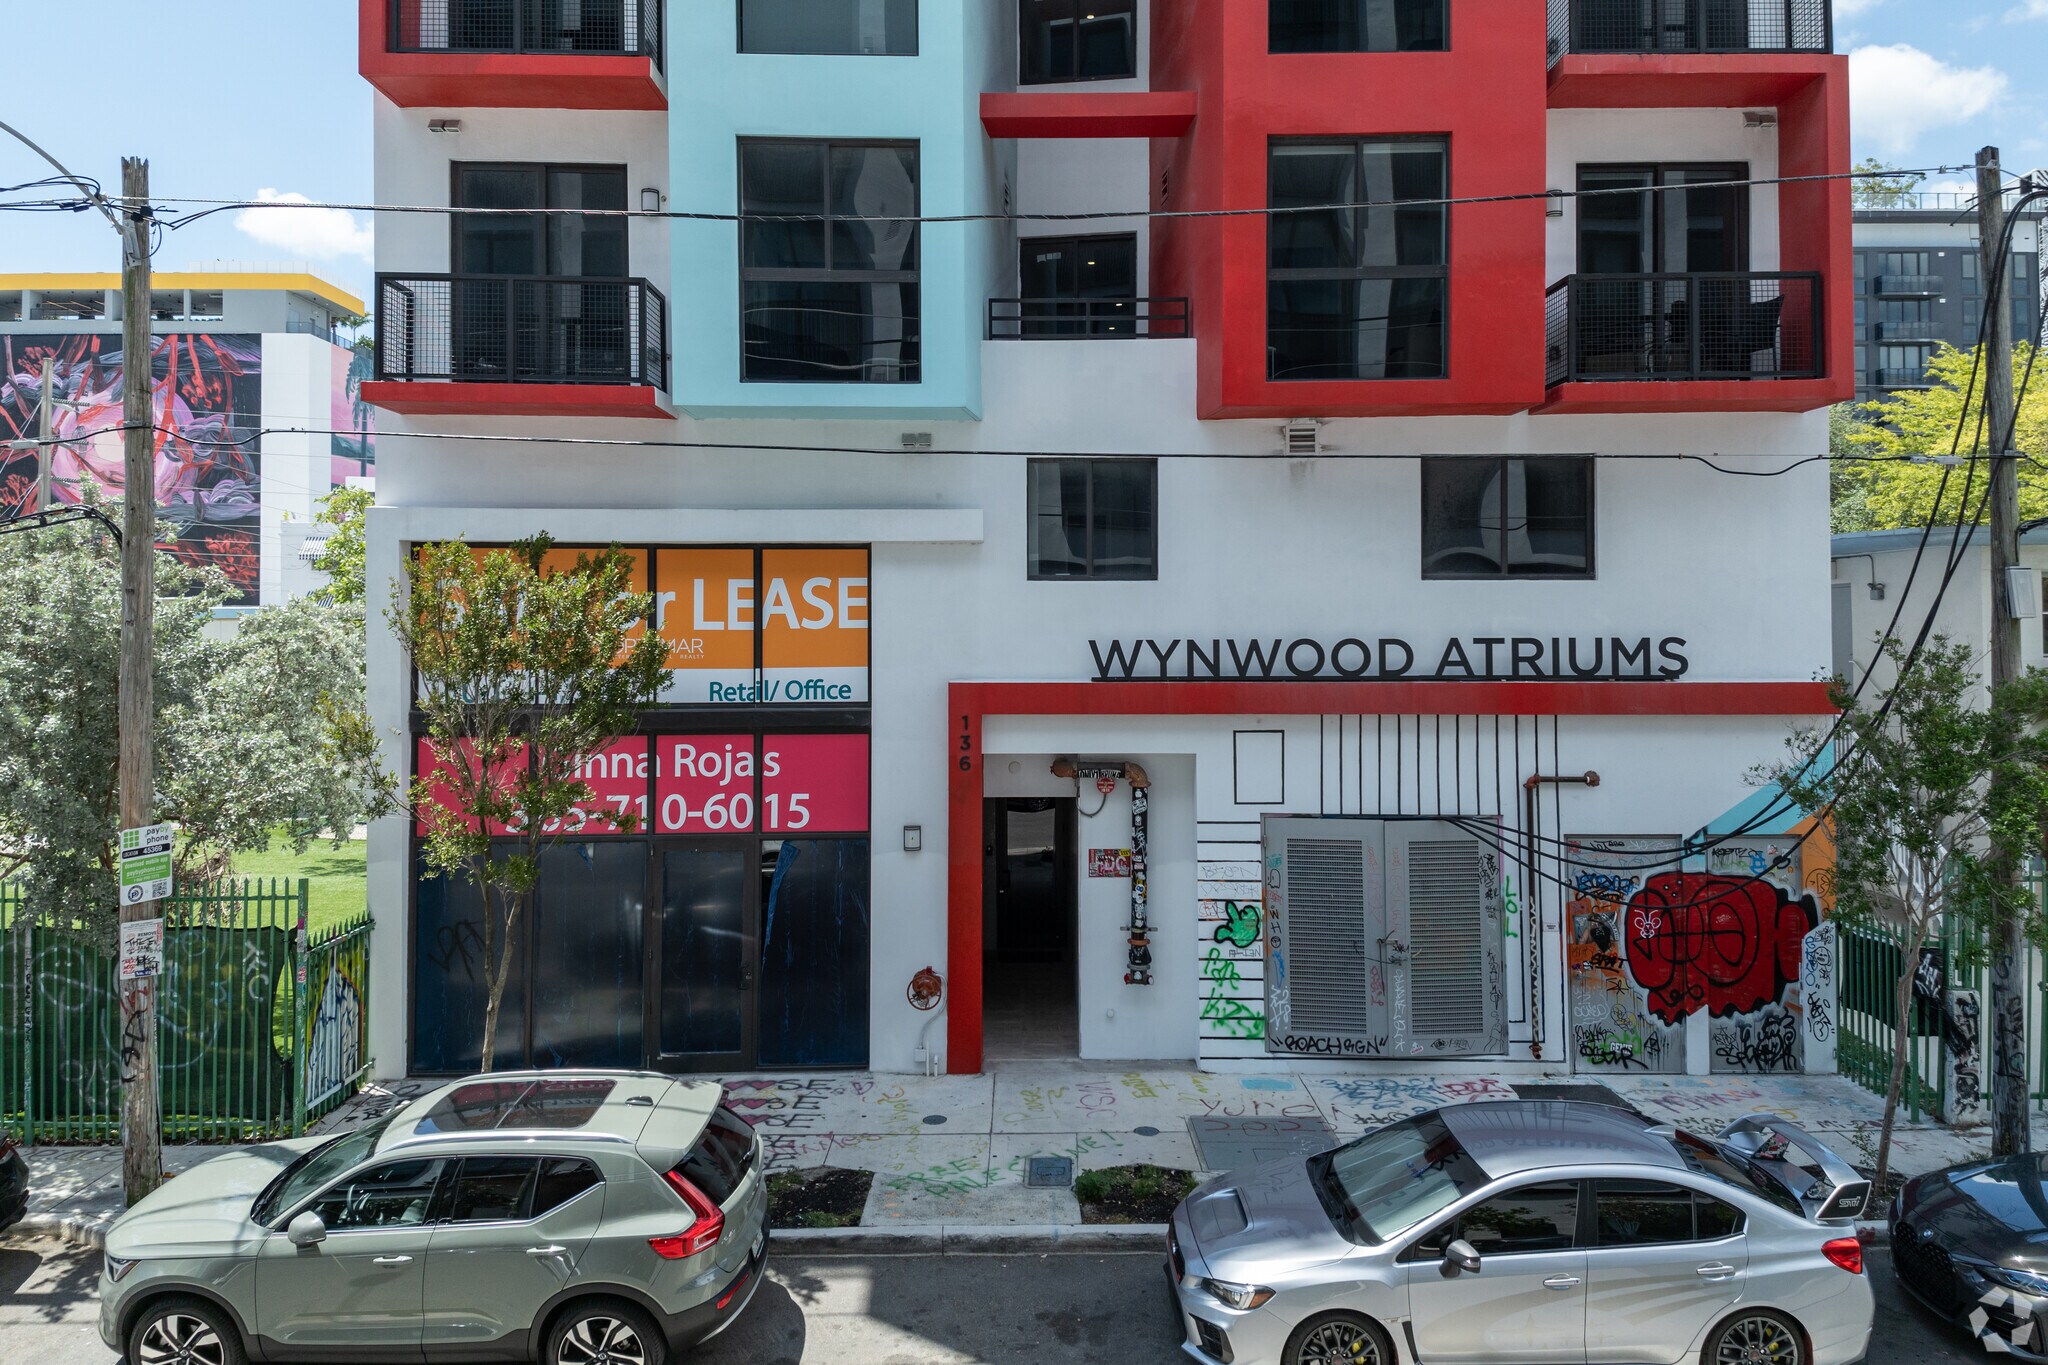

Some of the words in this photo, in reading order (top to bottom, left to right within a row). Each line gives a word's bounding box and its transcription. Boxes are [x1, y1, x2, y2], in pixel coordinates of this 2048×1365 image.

[693, 577, 869, 630] LEASE
[1088, 638, 1415, 677] WYNWOOD
[1435, 637, 1690, 677] ATRIUMS
[785, 679, 852, 700] Office
[959, 714, 972, 772] 136
[674, 744, 781, 786] Rojas
[146, 834, 169, 845] phone
